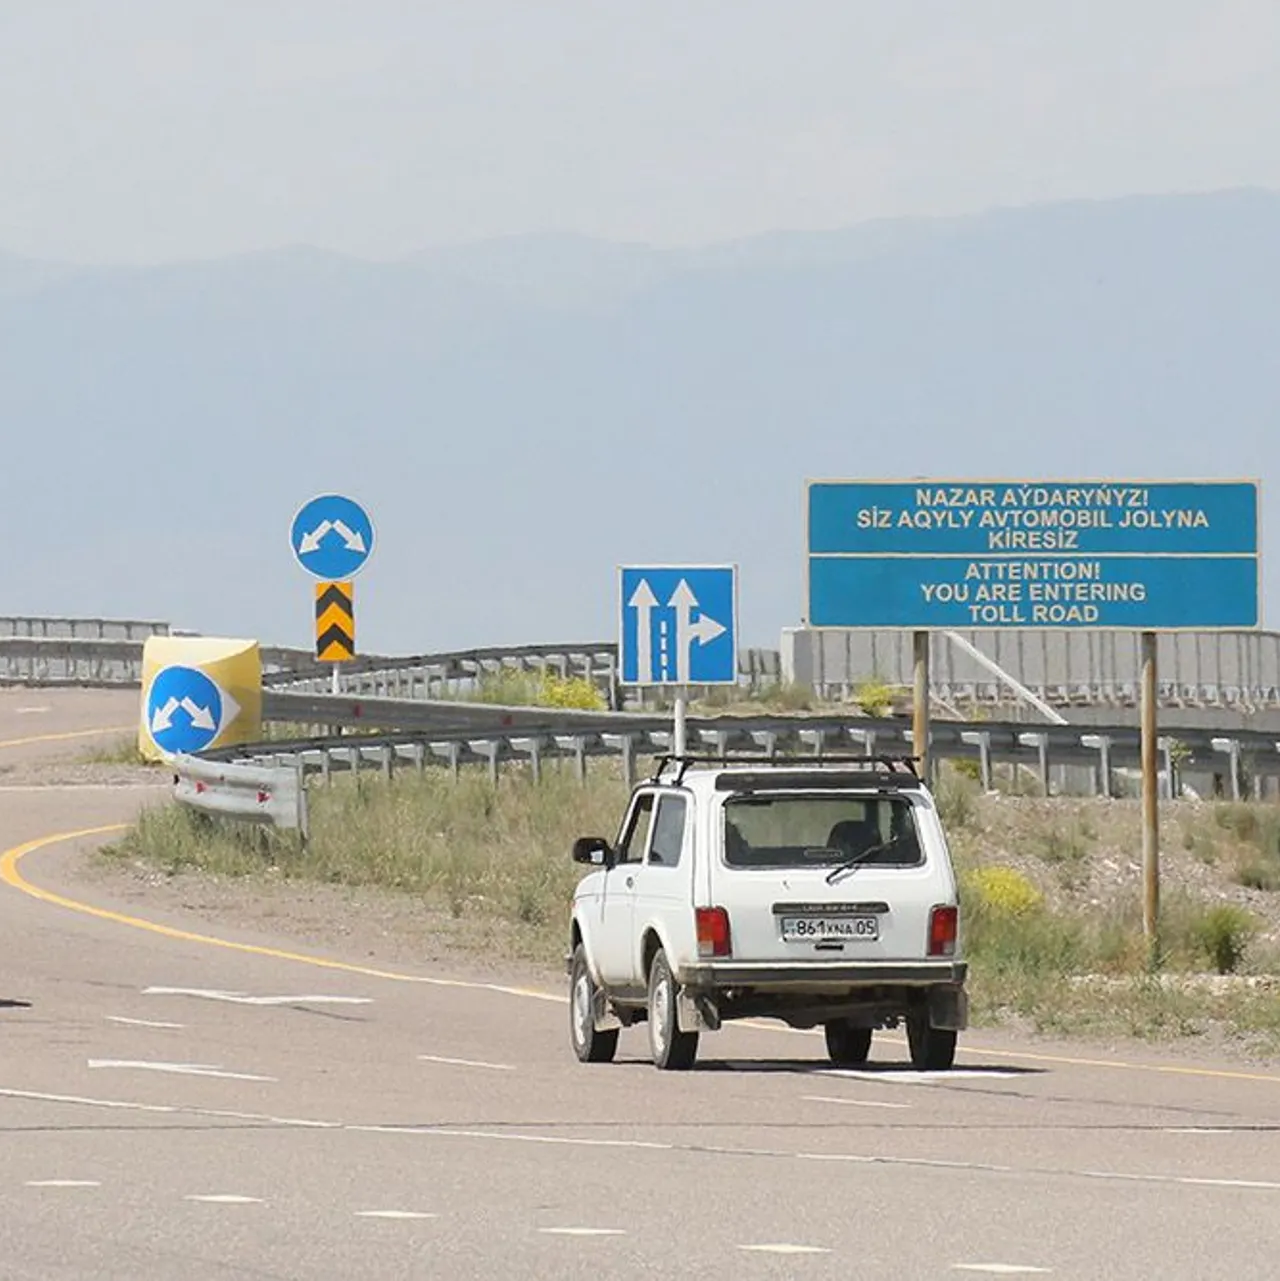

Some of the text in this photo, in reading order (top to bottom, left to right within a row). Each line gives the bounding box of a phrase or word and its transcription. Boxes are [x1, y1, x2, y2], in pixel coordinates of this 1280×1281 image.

[916, 488, 996, 507] NAZAR
[897, 509, 974, 529] AQYLY
[978, 509, 1113, 528] AVTOMOBIL
[1118, 509, 1209, 528] JOLYNA
[965, 562, 1101, 580] ATTENTION!
[921, 583, 1146, 602] YOU ARE ENTERING
[968, 604, 1099, 623] TOLL ROAD
